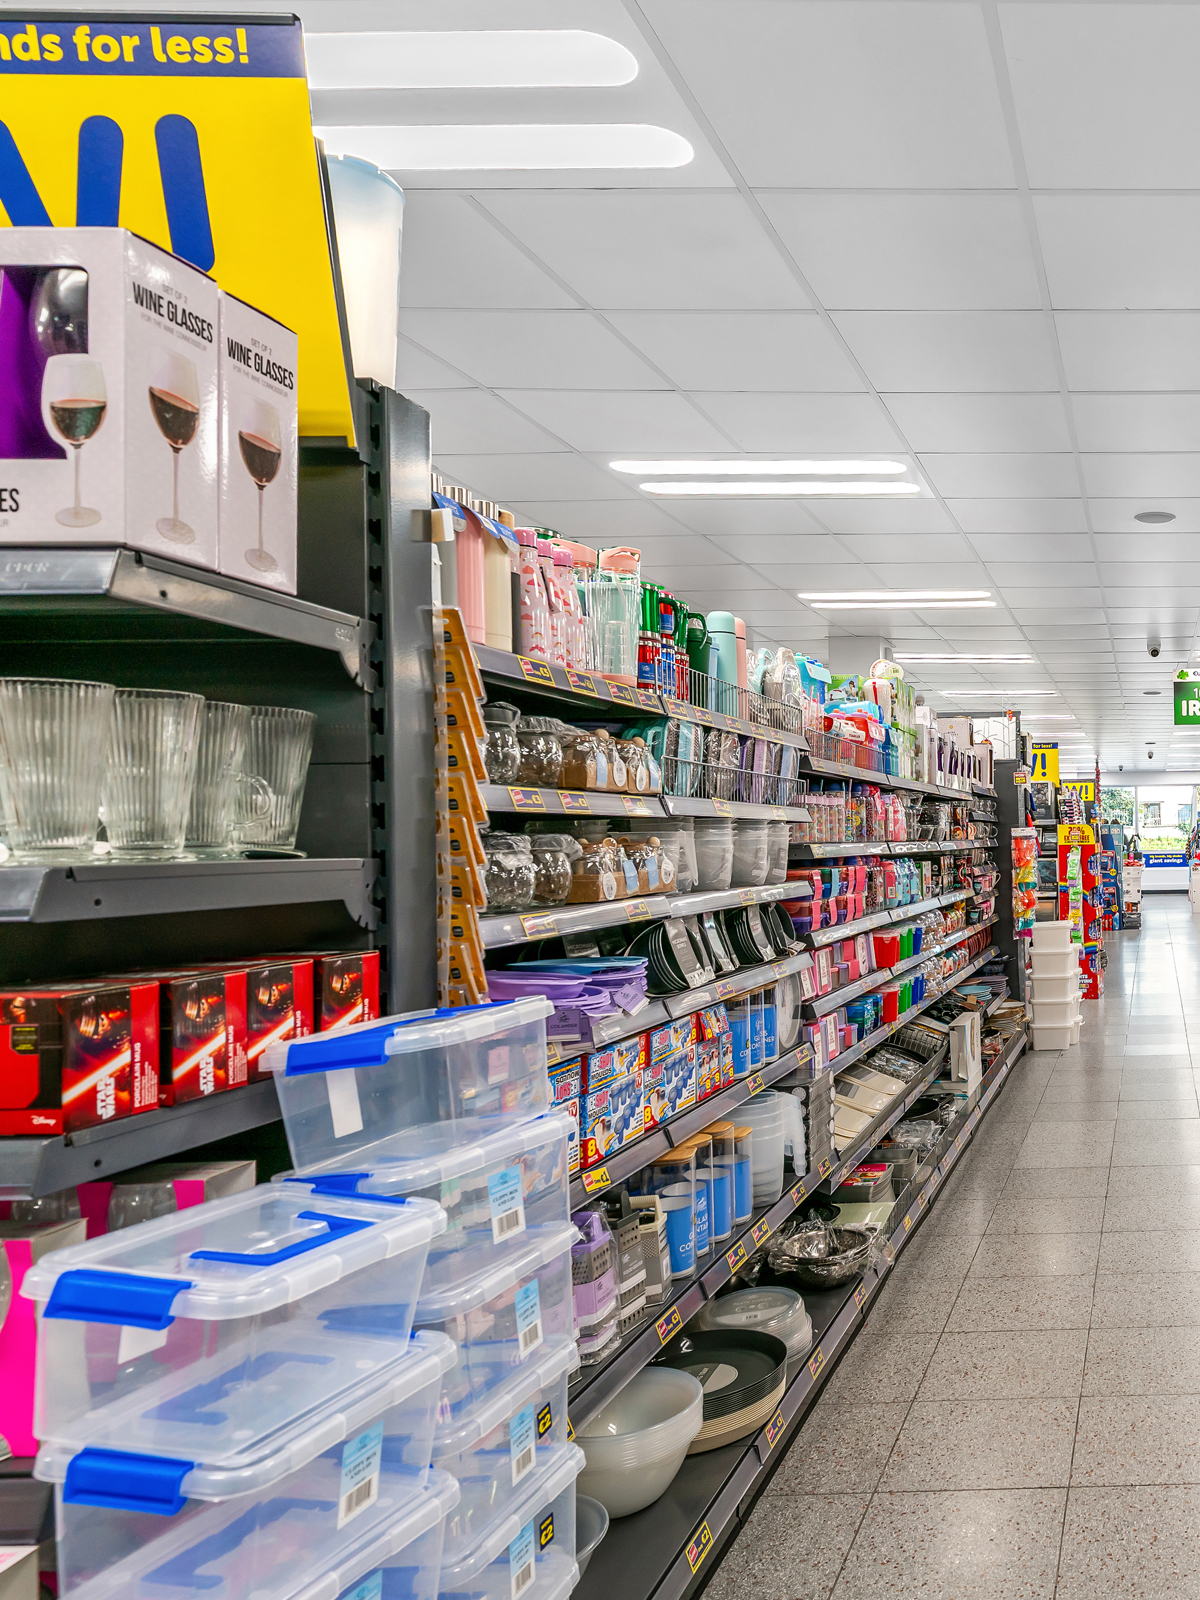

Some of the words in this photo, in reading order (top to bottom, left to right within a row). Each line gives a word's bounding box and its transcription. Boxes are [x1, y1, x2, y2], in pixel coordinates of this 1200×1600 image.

[72, 25, 140, 63] for
[150, 26, 249, 64] less!
[132, 281, 165, 318] WINE
[167, 300, 213, 344] GLASSES
[227, 337, 252, 369] WINE
[254, 352, 294, 390] GLASSES
[550, 1022, 577, 1030] COLANDER
[133, 1042, 141, 1061] MUG
[639, 1051, 646, 1064] 8
[591, 1067, 612, 1081] MOULDS
[133, 1061, 141, 1108] PORCELAIN
[96, 1076, 110, 1116] STAR
[102, 1076, 116, 1120] WARS
[588, 1104, 609, 1120] MOULDS
[644, 1107, 652, 1123] 8
[587, 1139, 597, 1153] 8
[601, 1171, 610, 1183] €1
[538, 1413, 552, 1434] €2
[540, 1524, 553, 1546] €2
